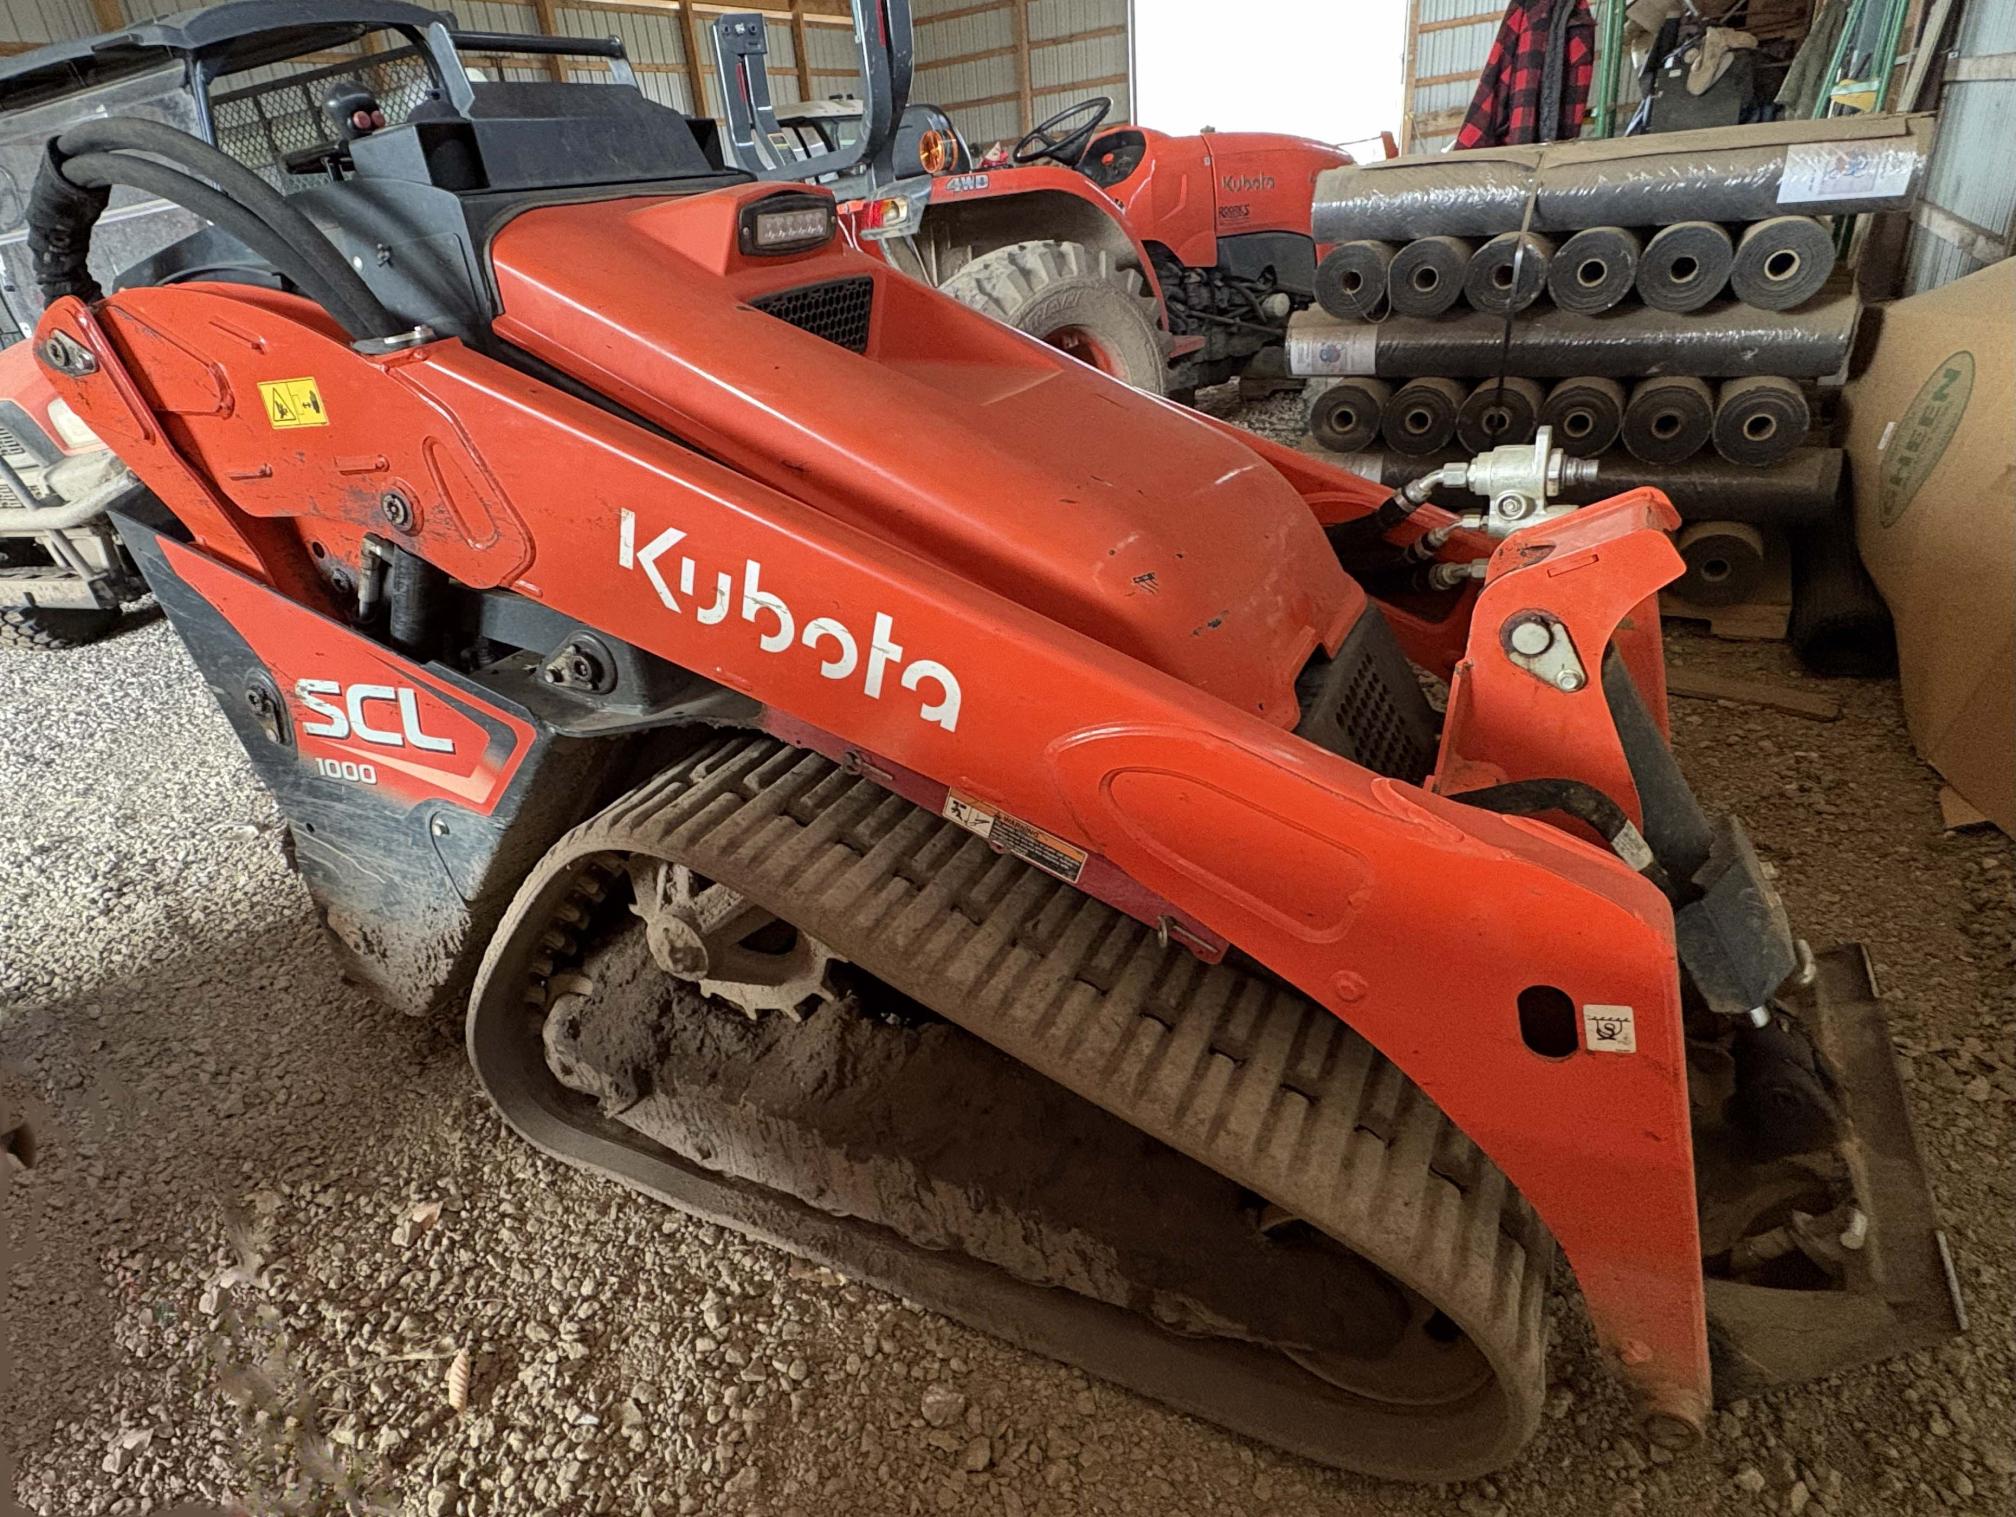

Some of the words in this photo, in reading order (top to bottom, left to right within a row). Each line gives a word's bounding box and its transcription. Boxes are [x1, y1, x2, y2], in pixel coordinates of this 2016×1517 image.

[946, 174, 989, 192] 4WD
[1220, 171, 1276, 193] Kubota
[618, 507, 962, 733] Kubota
[295, 678, 457, 755] SCL
[315, 757, 378, 785] 1000
[1003, 817, 1040, 838] WARNING
